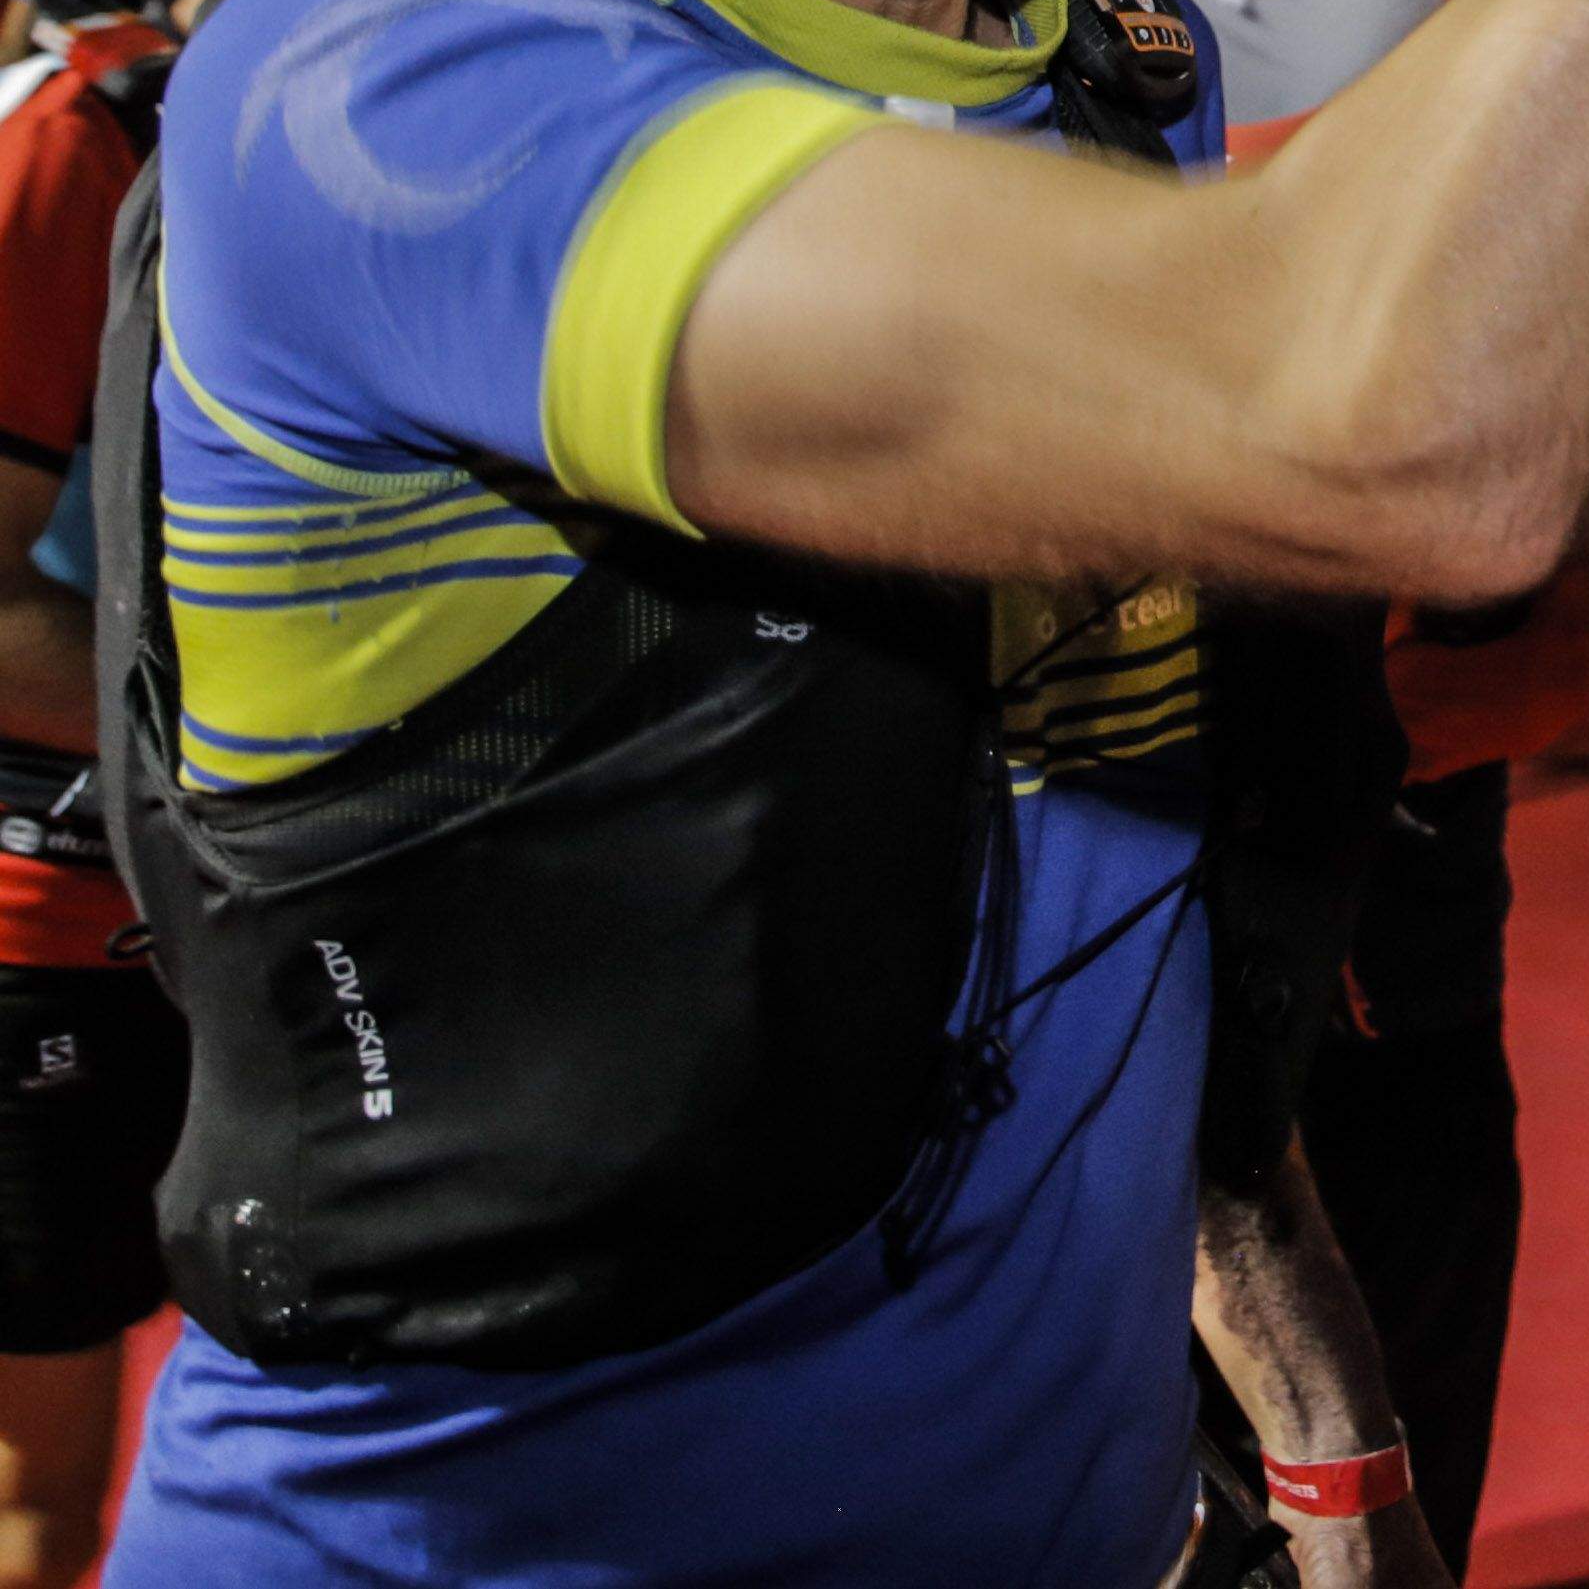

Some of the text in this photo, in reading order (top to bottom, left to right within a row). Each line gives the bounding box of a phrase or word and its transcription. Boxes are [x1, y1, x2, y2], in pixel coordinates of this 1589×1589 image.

[313, 938, 394, 1121] ADV SKIN 5
